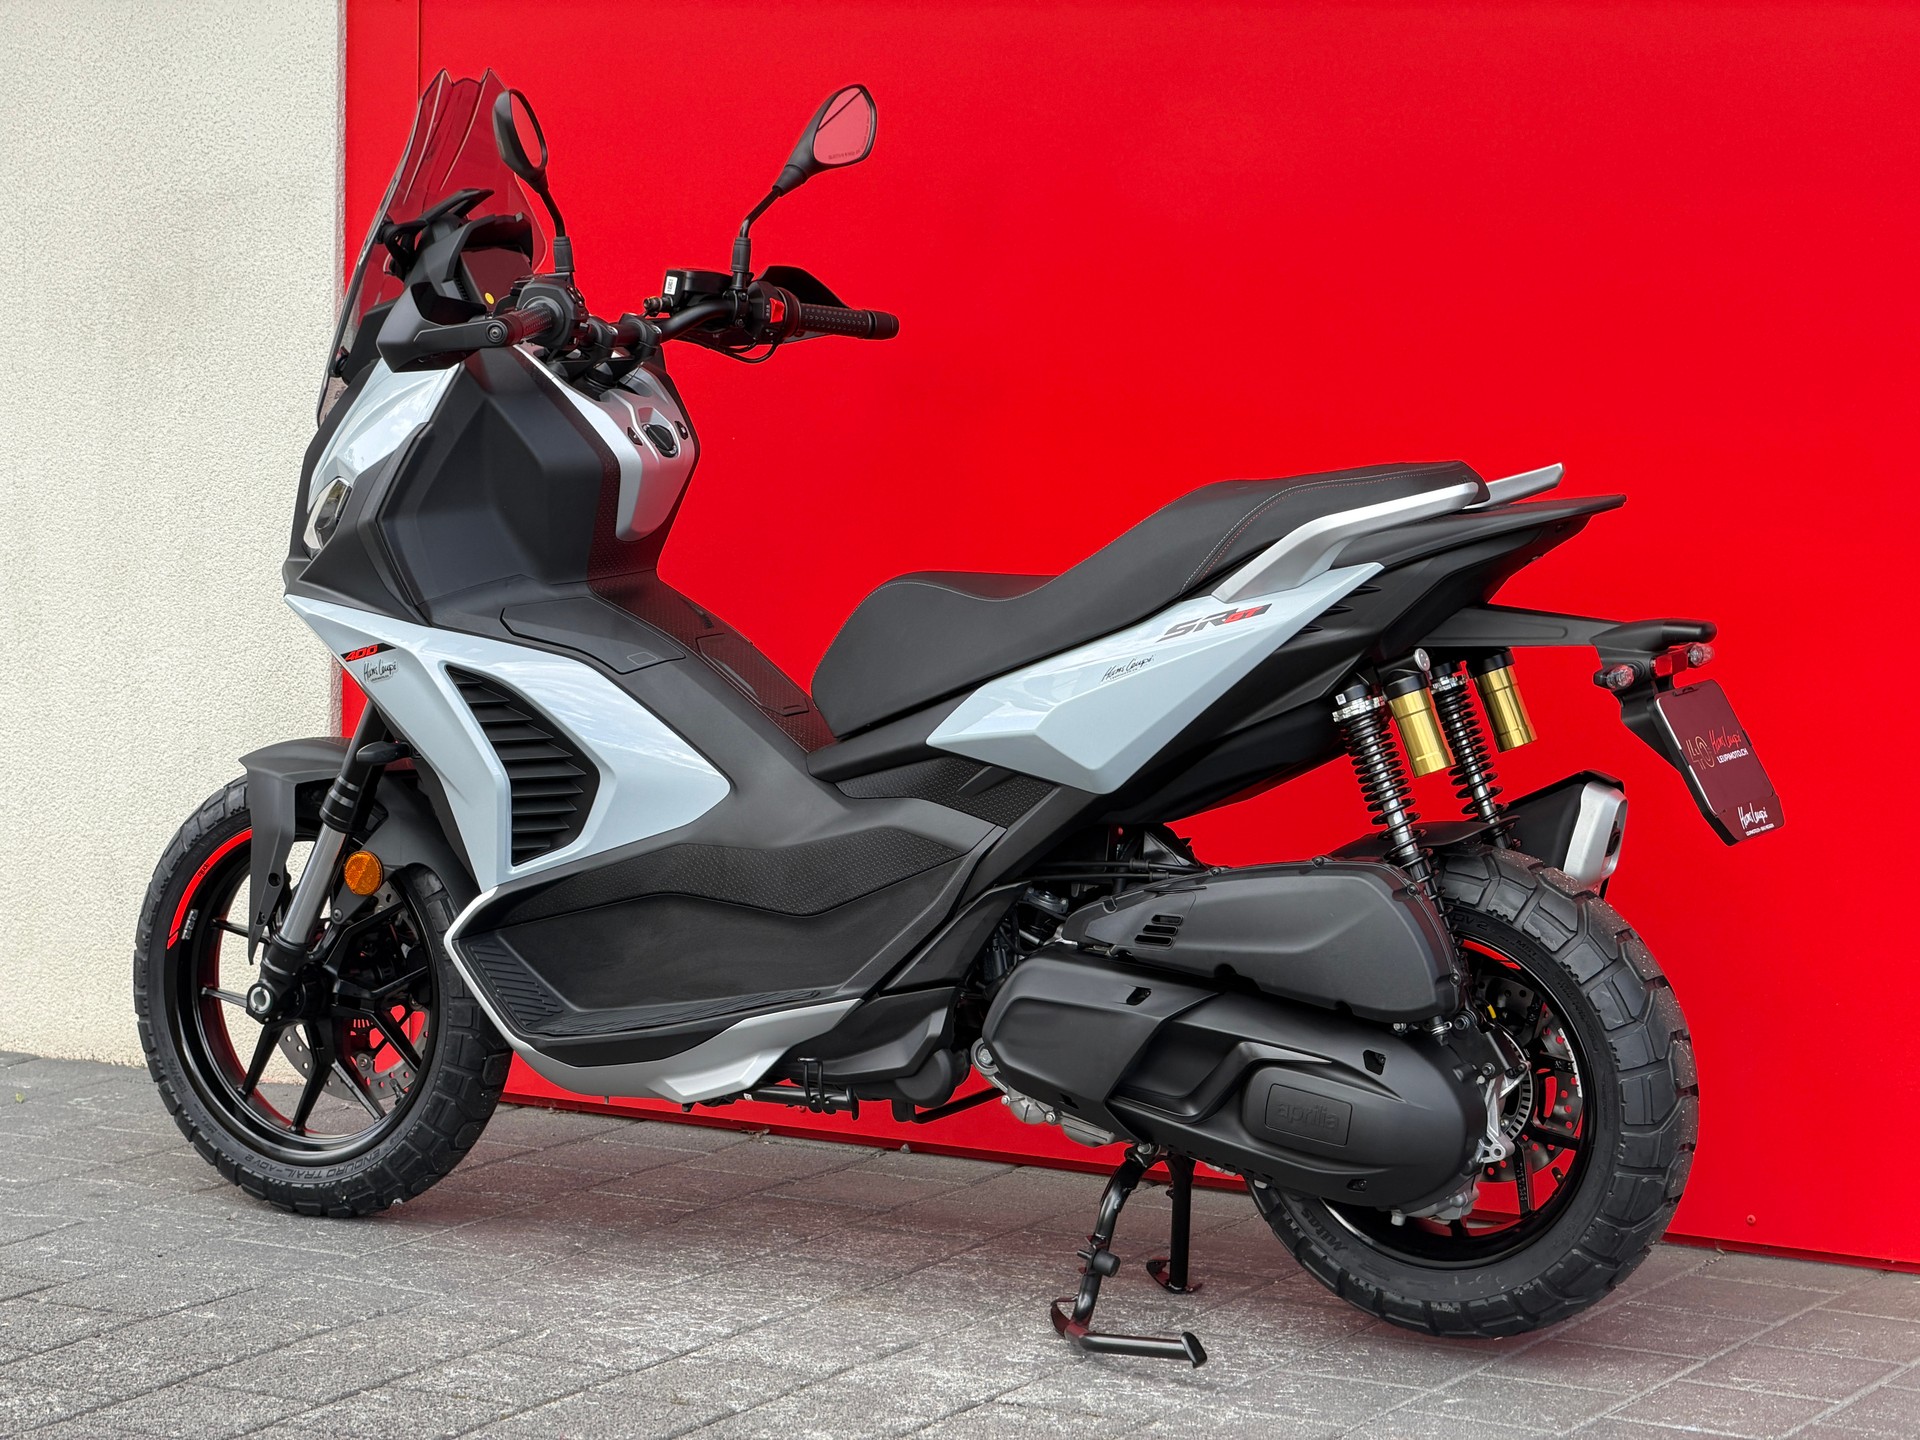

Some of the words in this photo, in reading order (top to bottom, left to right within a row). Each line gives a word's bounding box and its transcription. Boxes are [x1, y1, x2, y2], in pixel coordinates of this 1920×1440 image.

[344, 644, 379, 662] 400
[1277, 1103, 1340, 1130] aprilia
[325, 1147, 381, 1178] ENDURO
